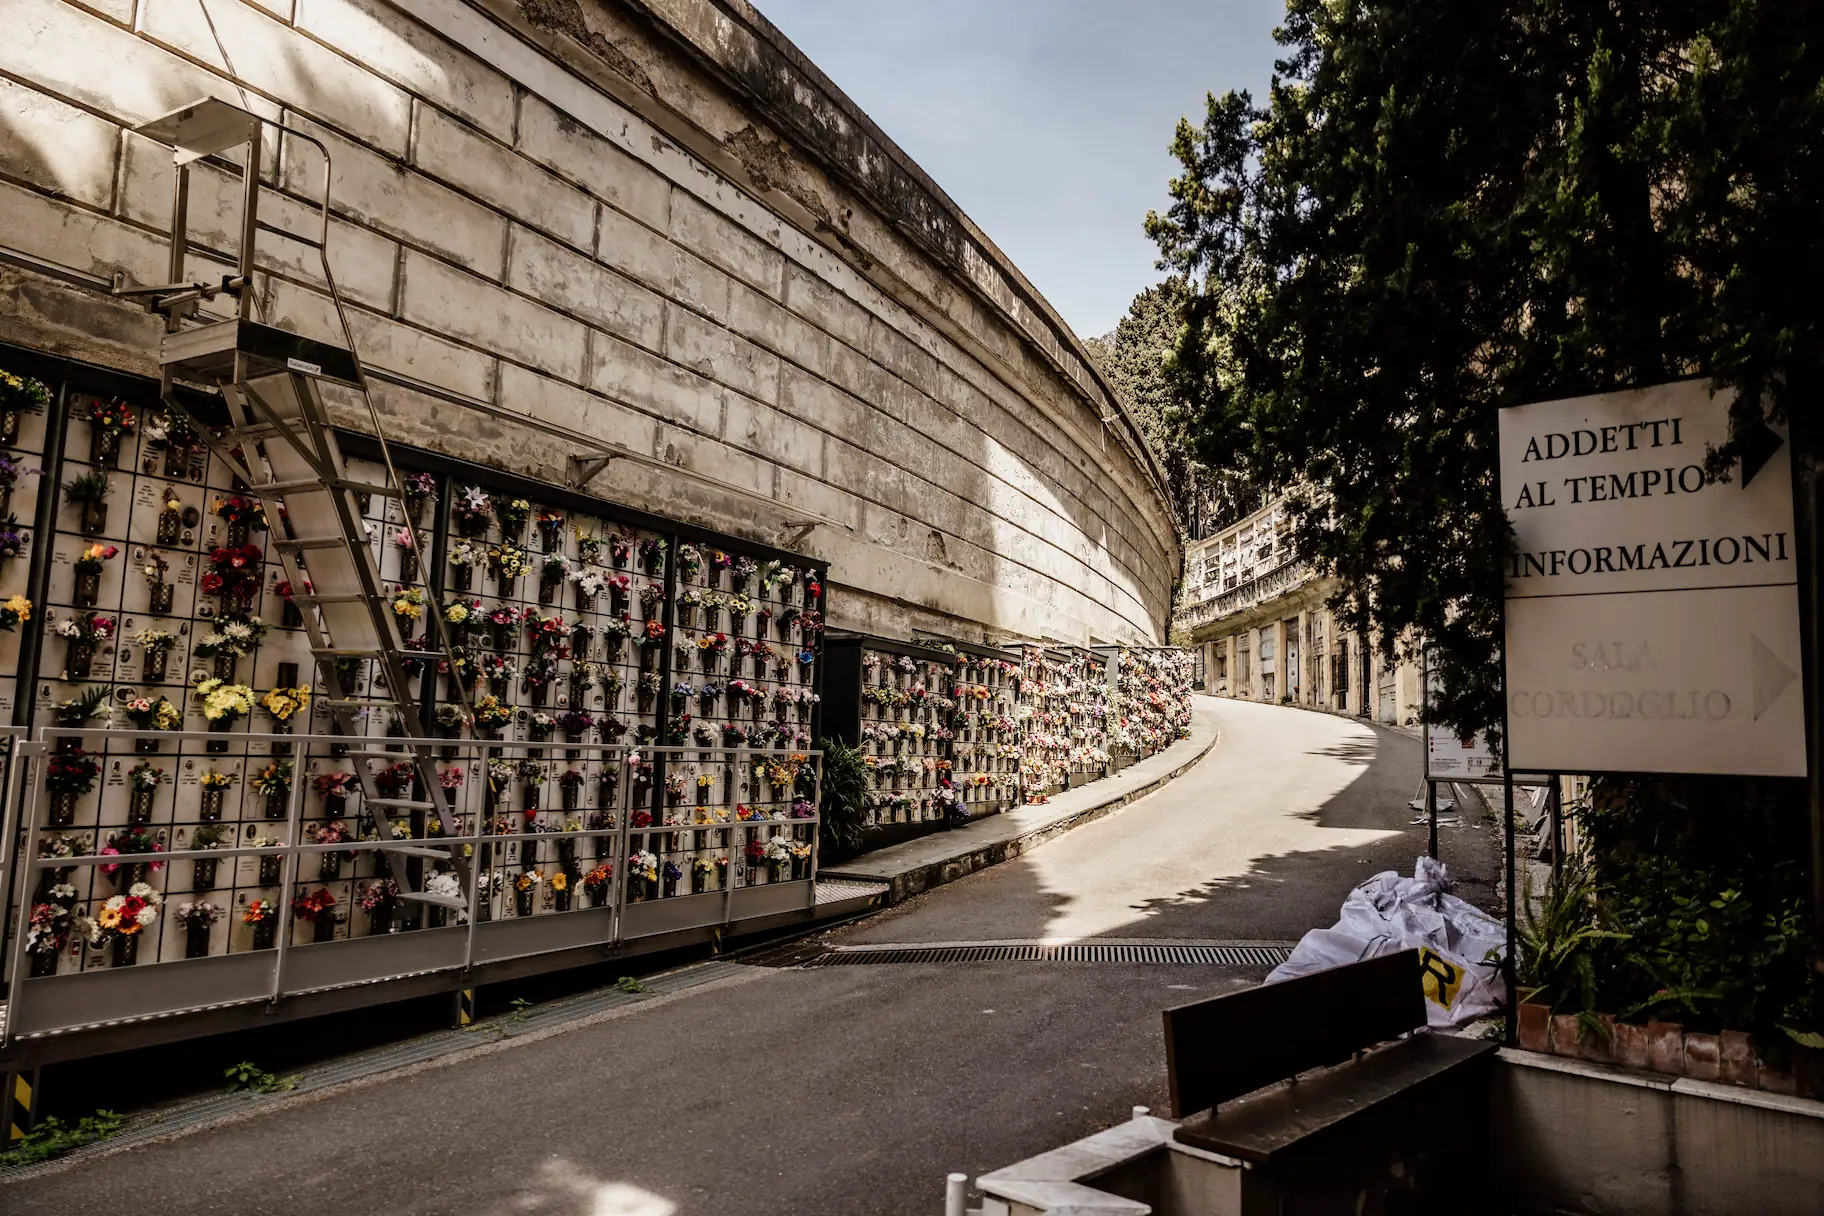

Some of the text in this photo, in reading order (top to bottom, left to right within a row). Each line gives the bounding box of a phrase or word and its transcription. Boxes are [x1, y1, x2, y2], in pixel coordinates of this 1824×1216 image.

[1521, 417, 1683, 463] ADDETTI
[1514, 465, 1705, 509] AL TEMPIO
[1510, 532, 1789, 579] INFORMAZIONI
[1510, 691, 1732, 720] CORDOGLIO
